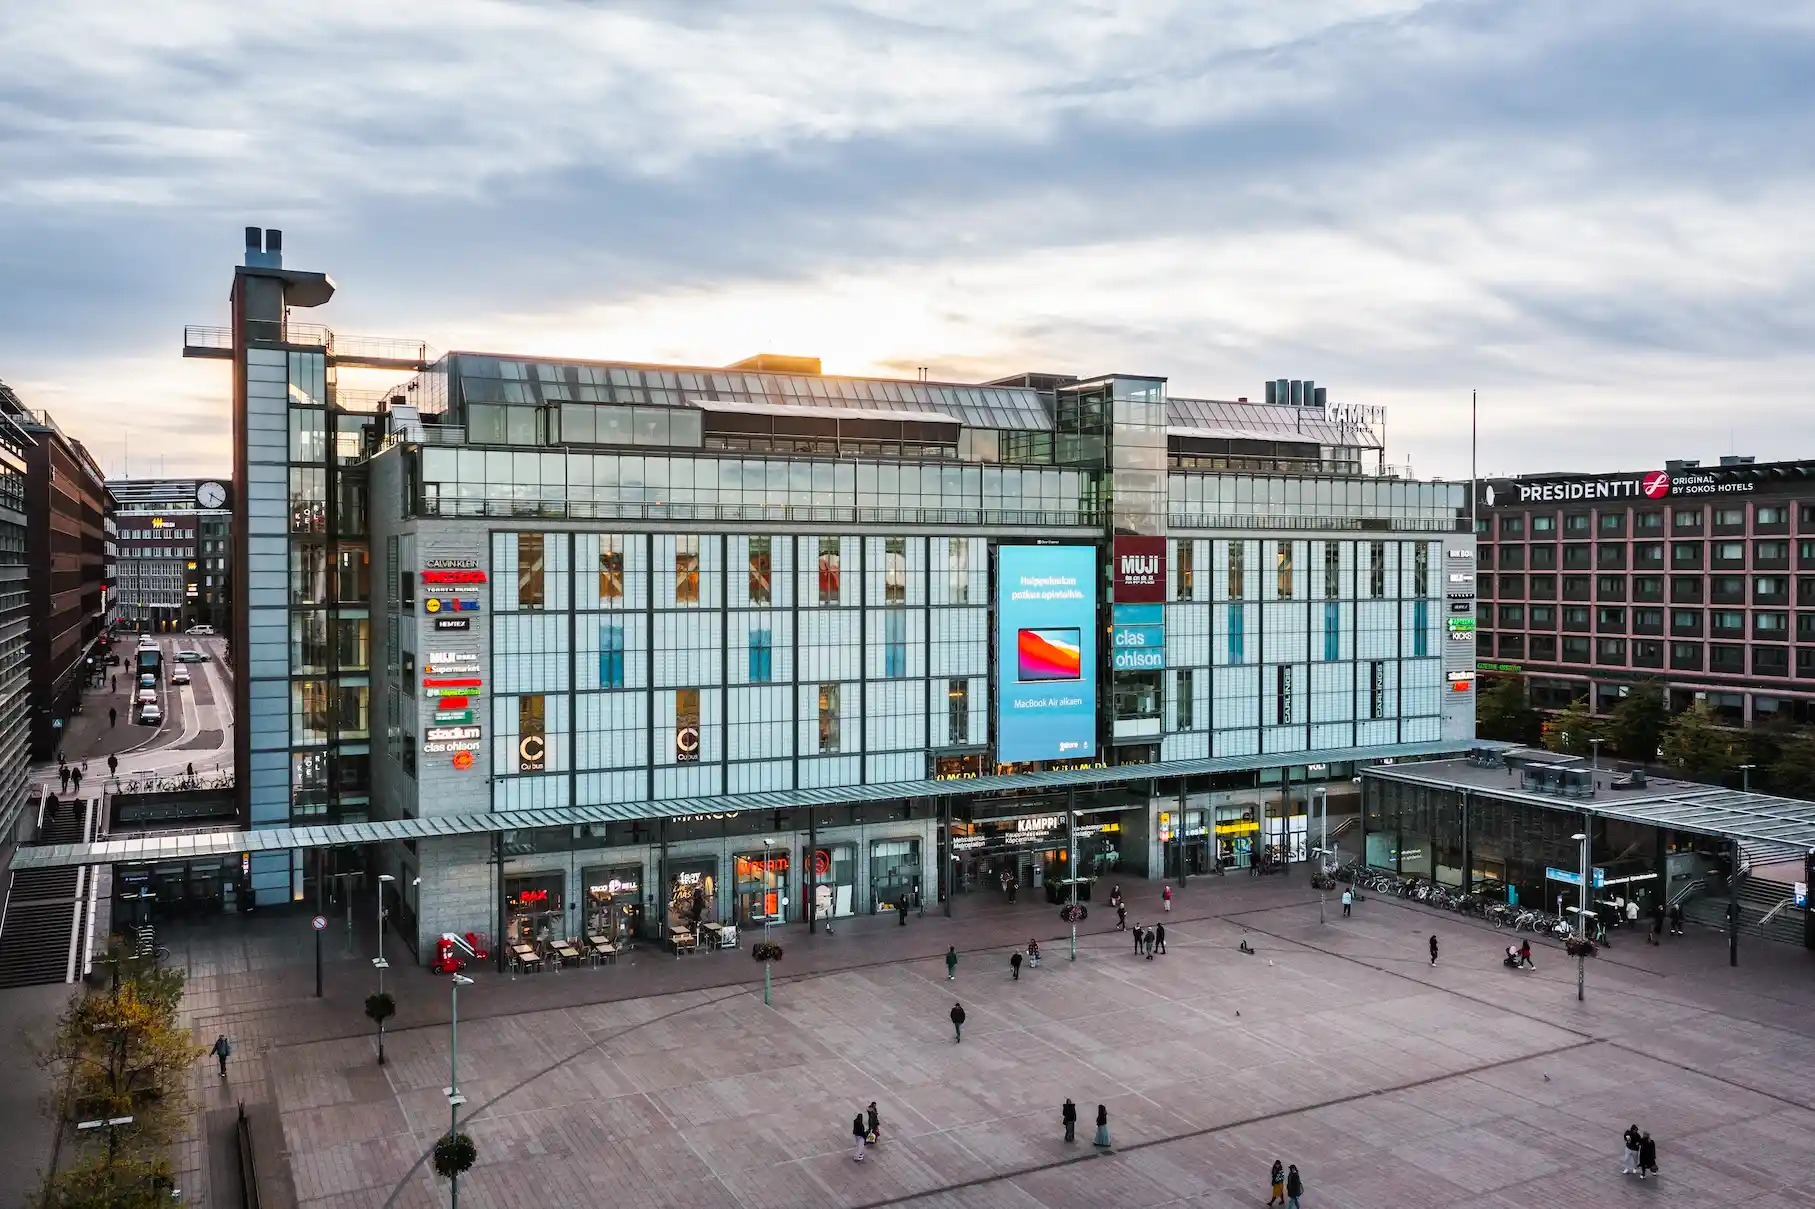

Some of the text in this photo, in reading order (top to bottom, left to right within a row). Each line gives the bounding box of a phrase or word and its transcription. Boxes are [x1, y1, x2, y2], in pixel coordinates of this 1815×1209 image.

[1325, 401, 1388, 424] KAMPPI
[1672, 475, 1715, 485] ORIGINAL
[1520, 480, 1640, 502] PRESIDENTTI
[1672, 483, 1754, 495] BY SOKOS HOTELS
[427, 560, 479, 568] CALVIN KLEIN
[1121, 556, 1159, 574] MUJI
[1116, 630, 1145, 645] clas
[1452, 632, 1473, 640] KICKS
[1116, 651, 1162, 666] ohlson
[431, 665, 480, 674] Supermarket
[1014, 699, 1046, 708] MacBook
[1048, 698, 1058, 706] Air
[427, 728, 480, 741] stadium
[424, 741, 480, 752] clas ohlson
[1018, 816, 1057, 831] KAMPPI
[590, 882, 638, 893] TACO BELL
[520, 889, 548, 901] RAX
